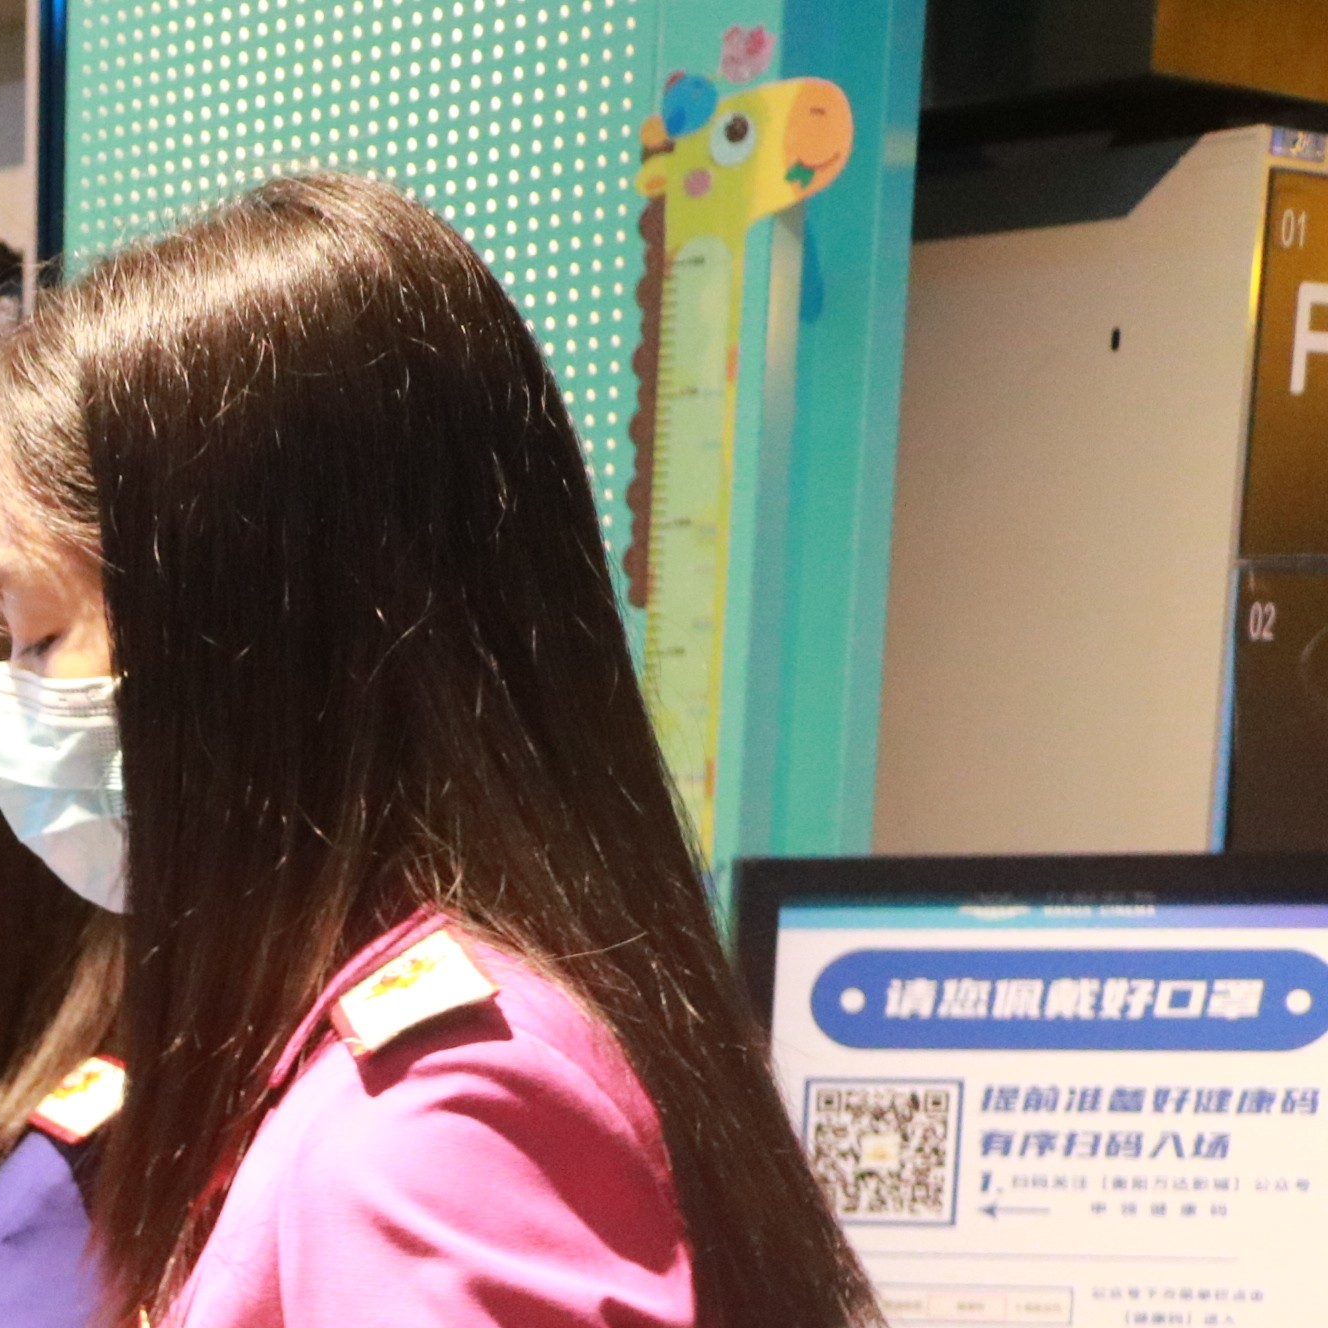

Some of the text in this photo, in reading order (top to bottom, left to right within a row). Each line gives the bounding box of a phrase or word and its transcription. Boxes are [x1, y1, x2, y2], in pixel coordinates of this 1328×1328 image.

[1281, 208, 1307, 250] 01
[1249, 601, 1276, 641] 02
[885, 976, 1265, 1021] 请您佩戴好口罩
[980, 1085, 1320, 1115] 提前准备好健康码
[980, 1130, 1231, 1159] 有序扫码入场
